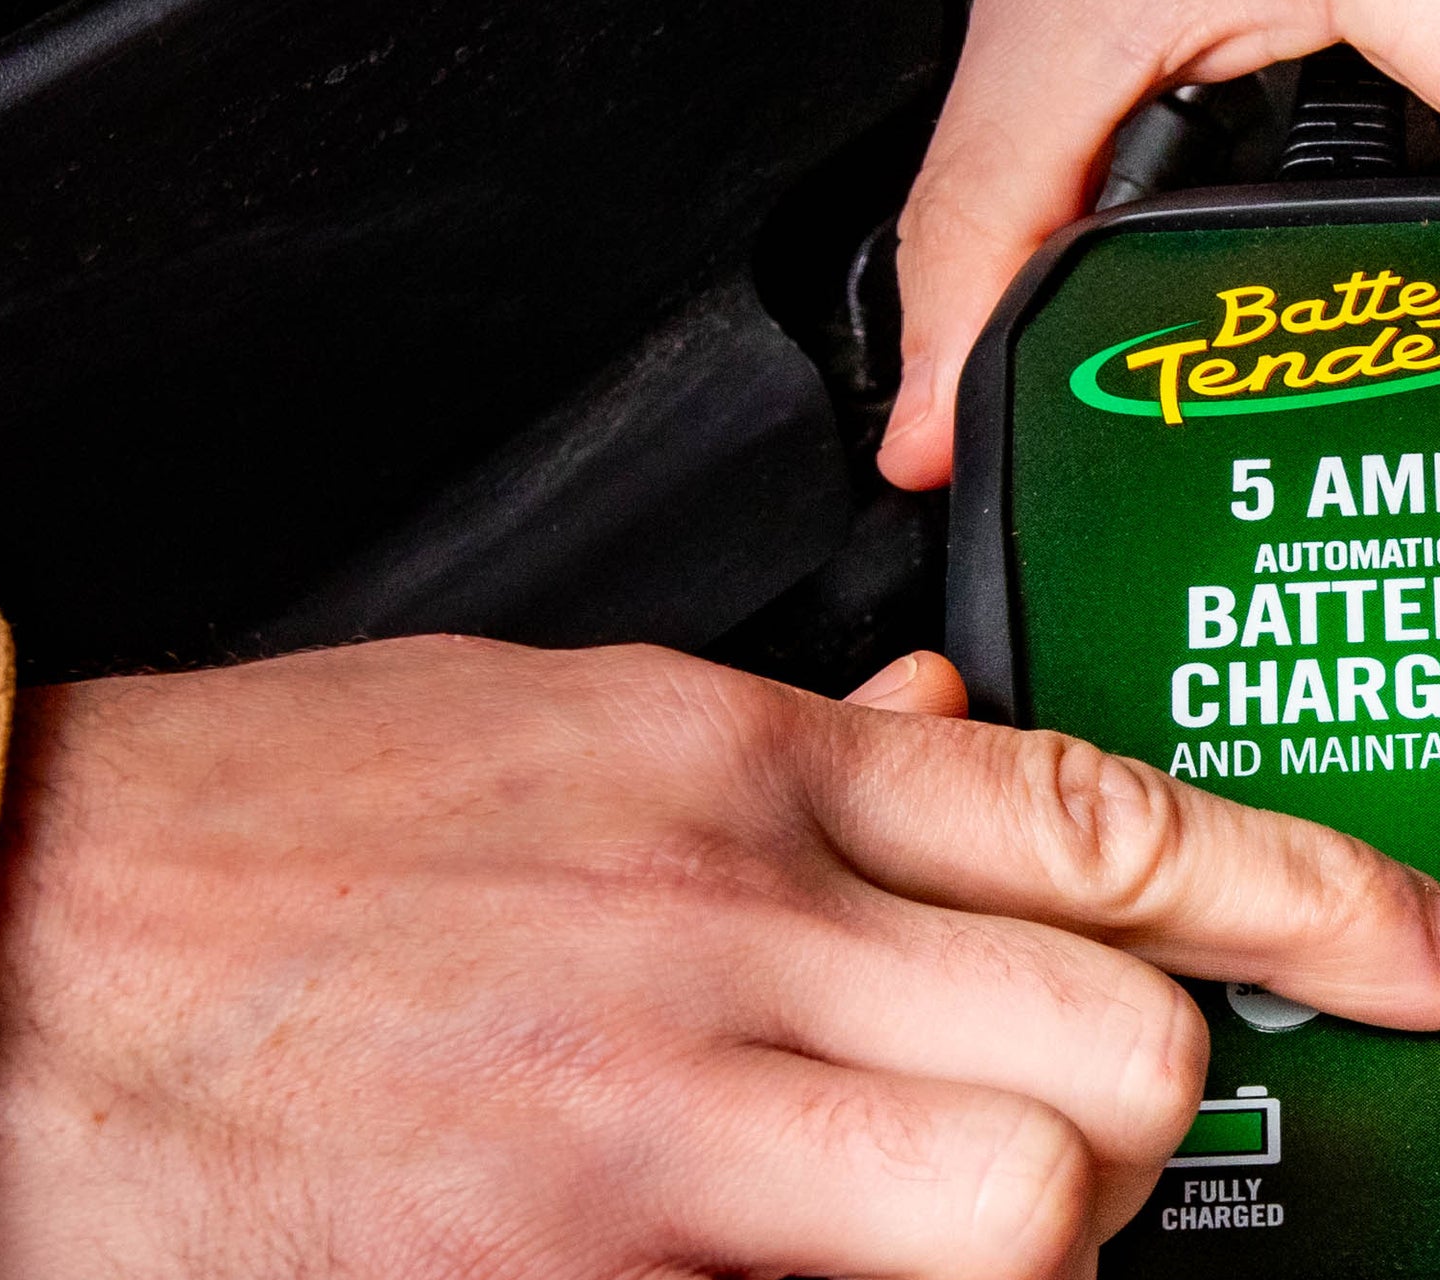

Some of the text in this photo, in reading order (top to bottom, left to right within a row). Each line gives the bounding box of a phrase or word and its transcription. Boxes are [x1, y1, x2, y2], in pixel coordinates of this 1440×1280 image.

[1231, 458, 1275, 521] 5
[1169, 740, 1262, 778] AND
[1184, 1178, 1262, 1203] FULLY
[1162, 1203, 1284, 1230] CHARGED
